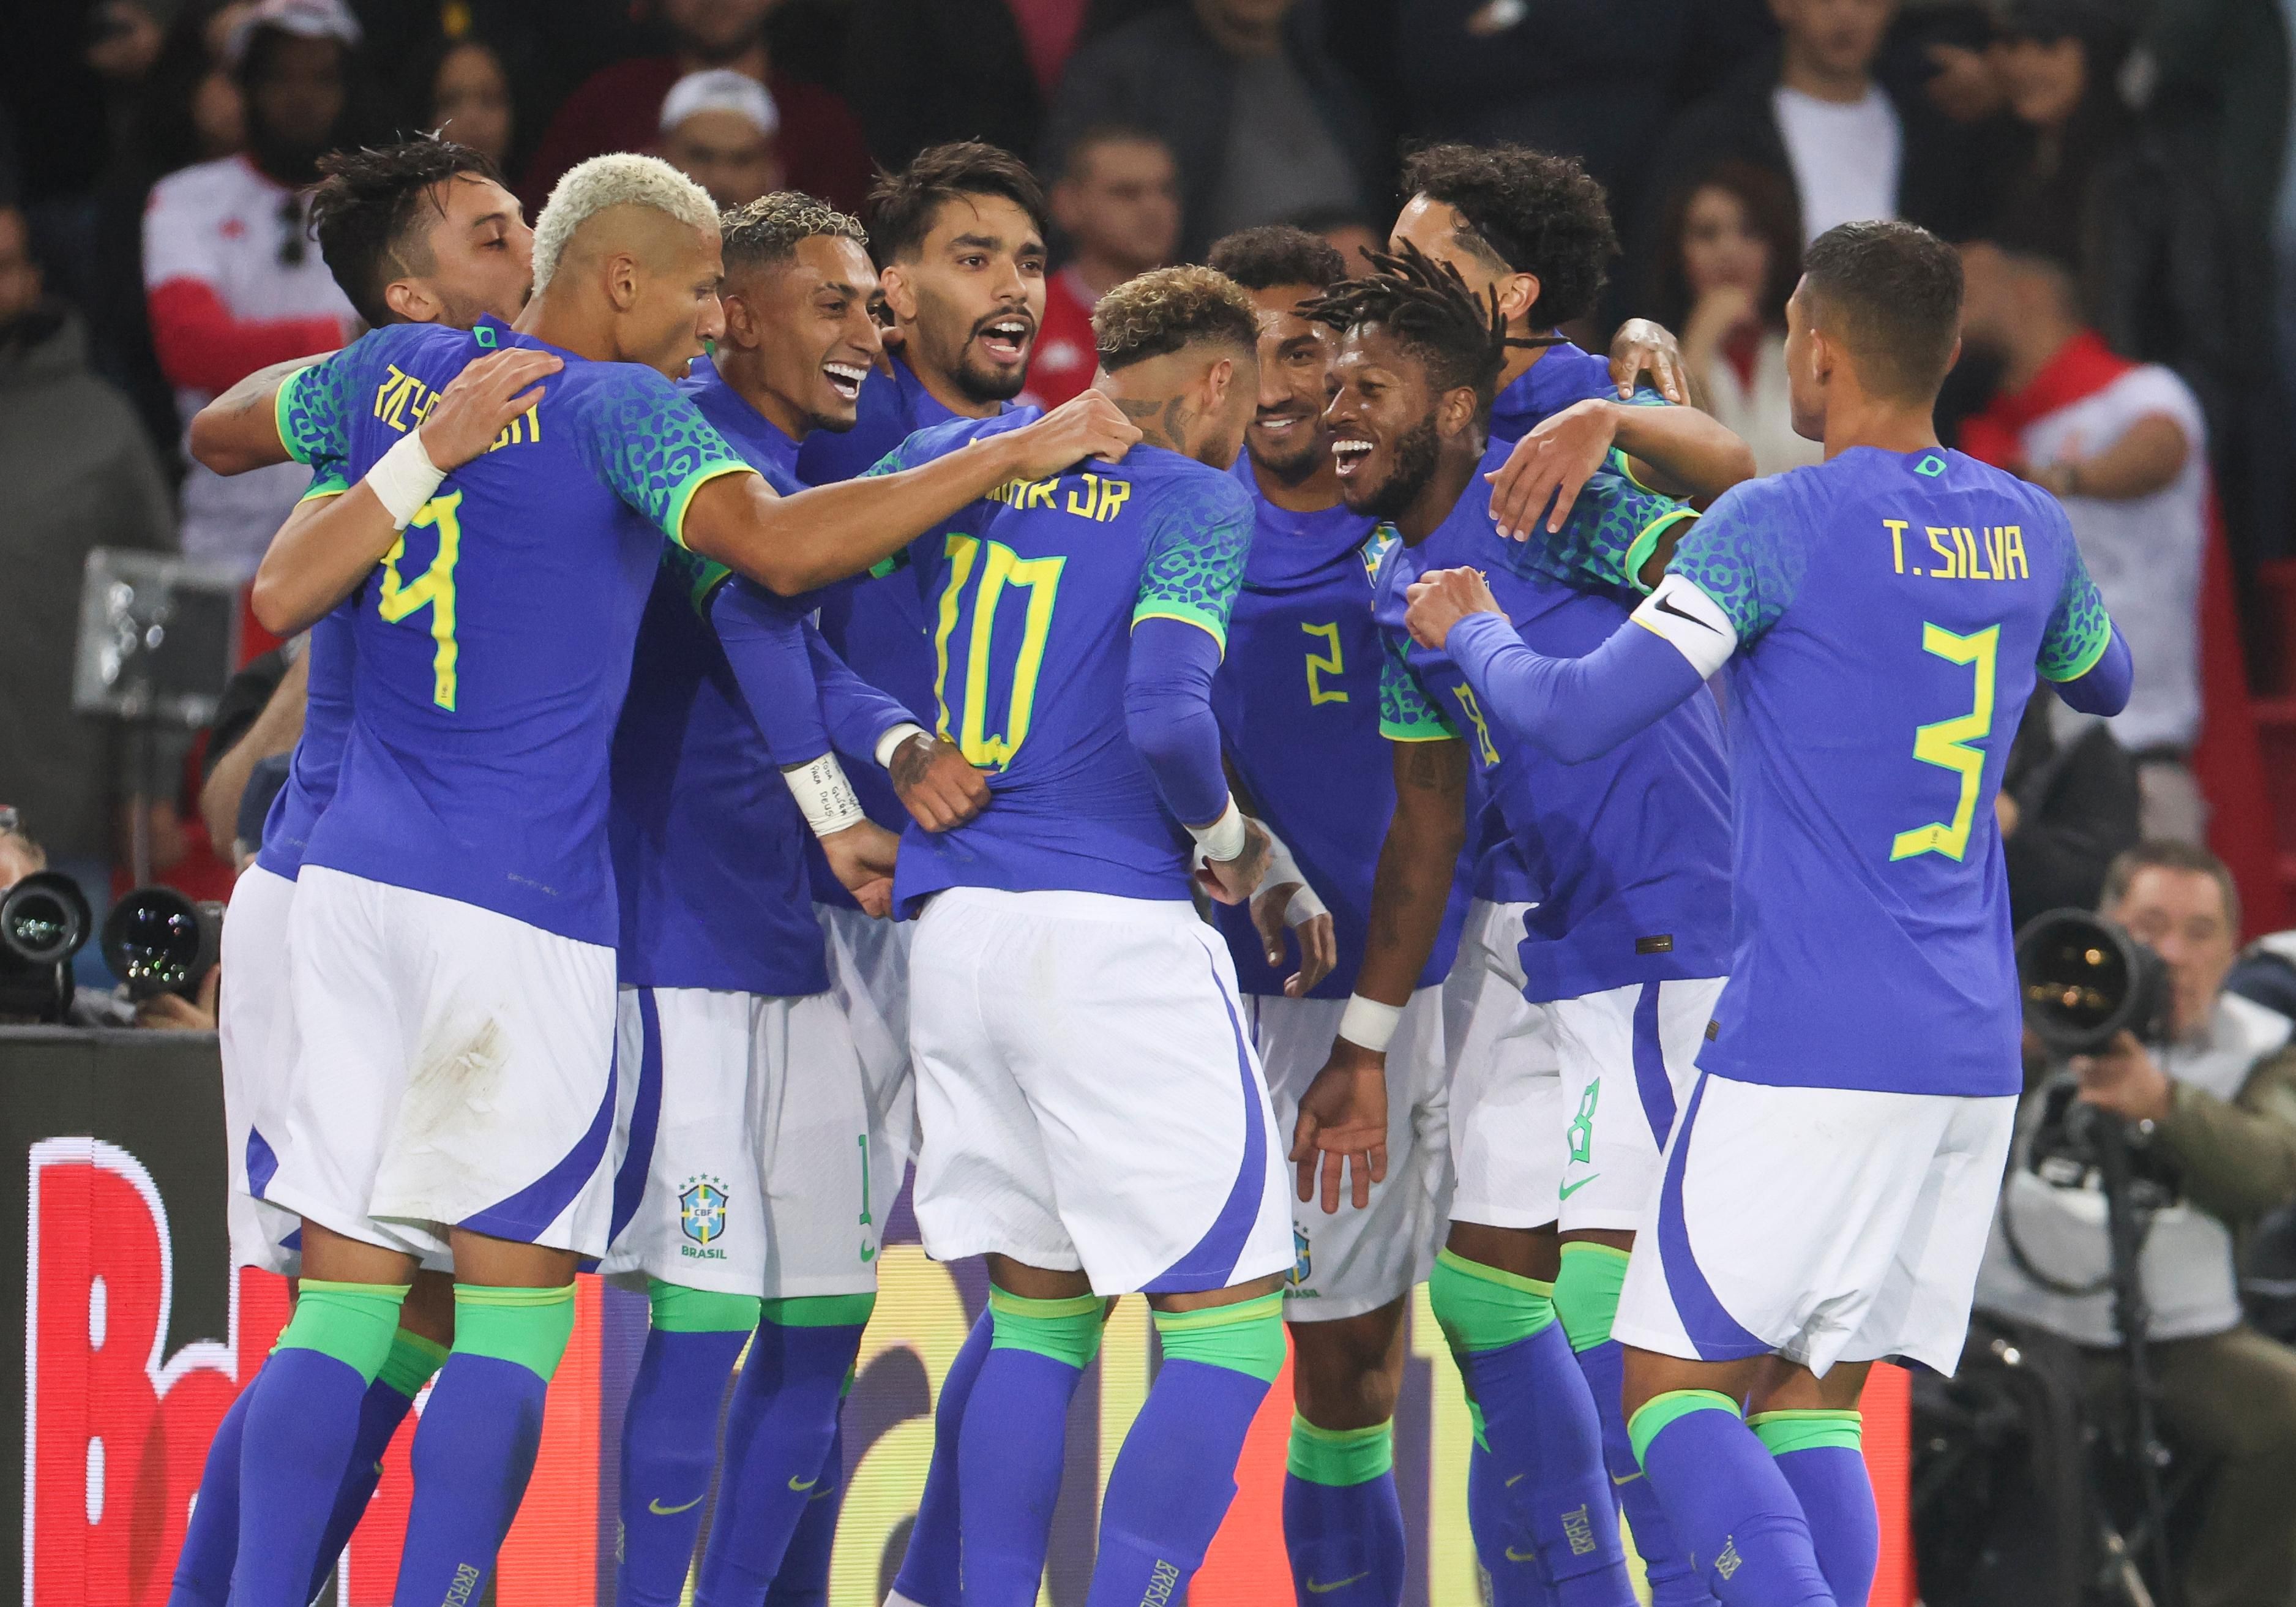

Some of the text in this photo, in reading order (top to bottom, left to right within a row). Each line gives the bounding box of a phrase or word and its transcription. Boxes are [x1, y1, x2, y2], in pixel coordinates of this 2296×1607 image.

[1067, 473, 1131, 522] JR
[1883, 519, 2029, 580] T. SILVA
[378, 489, 463, 713] 9
[934, 533, 1068, 773] 10
[1301, 621, 1350, 706] 2
[1451, 681, 1500, 767] 8
[1890, 621, 2000, 862] 3
[820, 791, 834, 817] DEUS
[1568, 1076, 1600, 1166] 8
[681, 1245, 728, 1260] BRASIL
